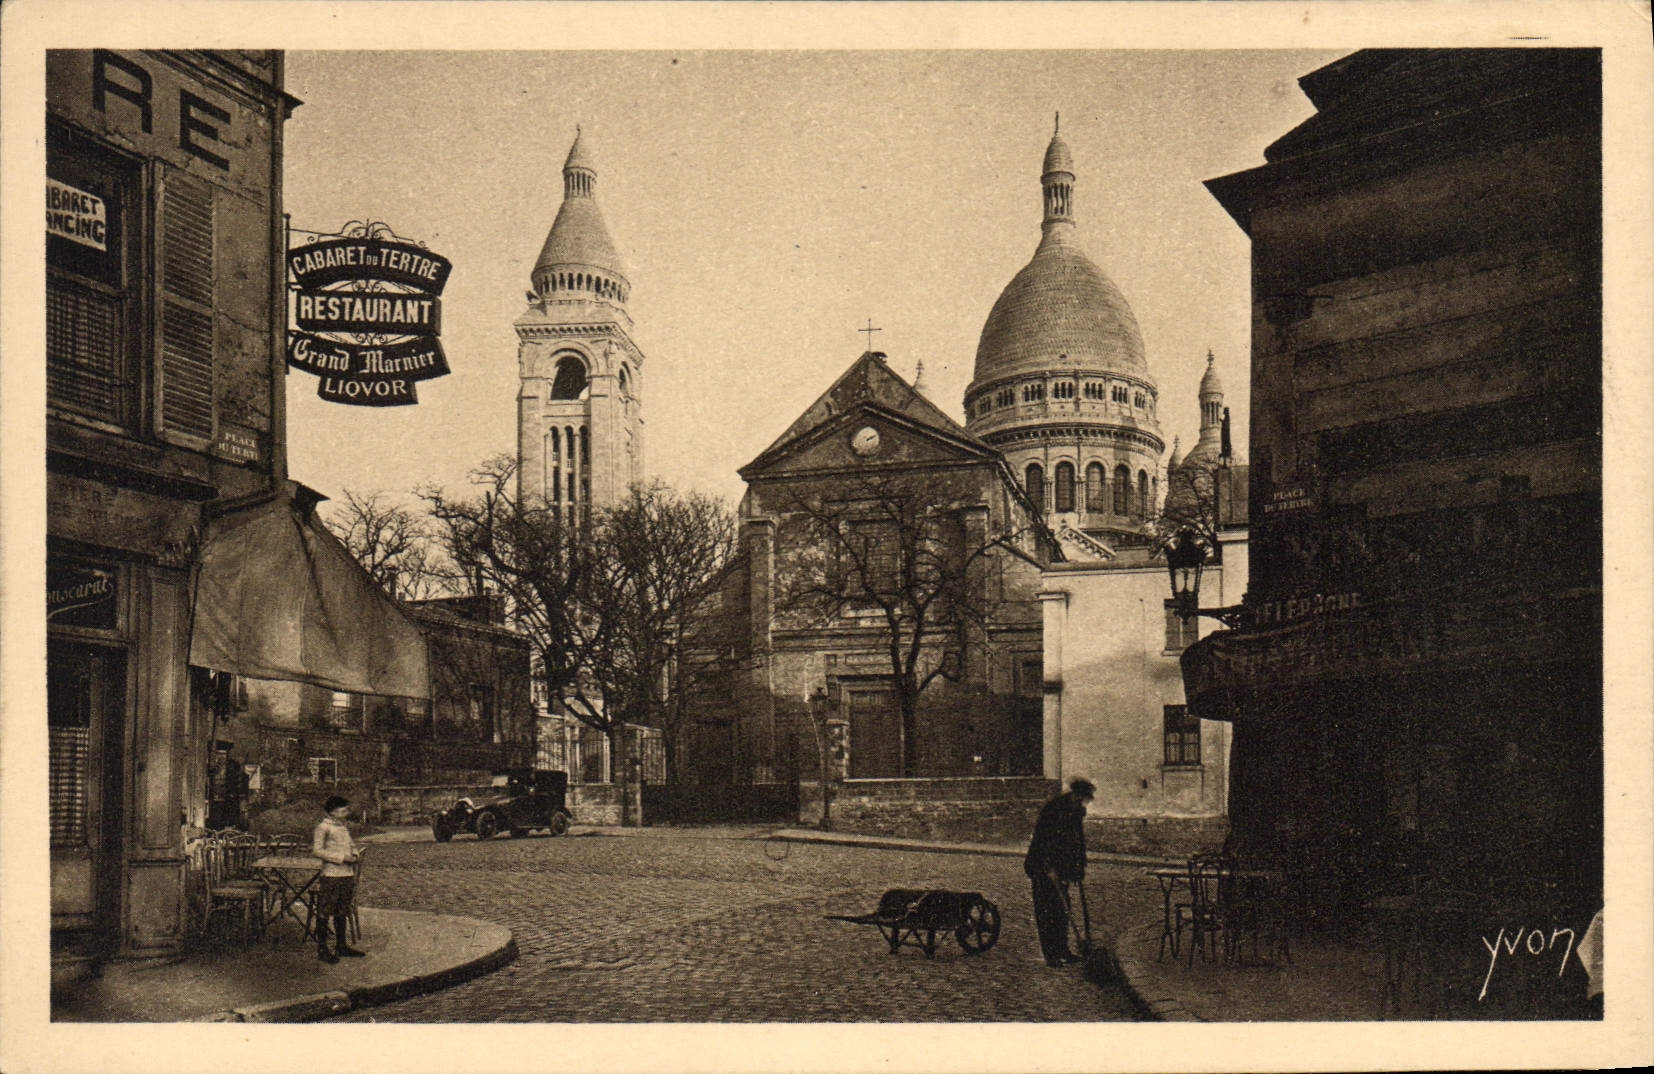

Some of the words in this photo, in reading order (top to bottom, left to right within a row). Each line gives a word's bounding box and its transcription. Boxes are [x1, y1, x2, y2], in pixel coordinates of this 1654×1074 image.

[293, 246, 367, 275] CABARET
[367, 255, 378, 266] DU
[380, 248, 441, 280] TERTRE
[300, 296, 432, 324] RESTAURANT
[293, 339, 350, 371] Grand
[358, 349, 435, 374] Marnier
[225, 432, 256, 448] PLACE
[1273, 488, 1304, 501] PLACE
